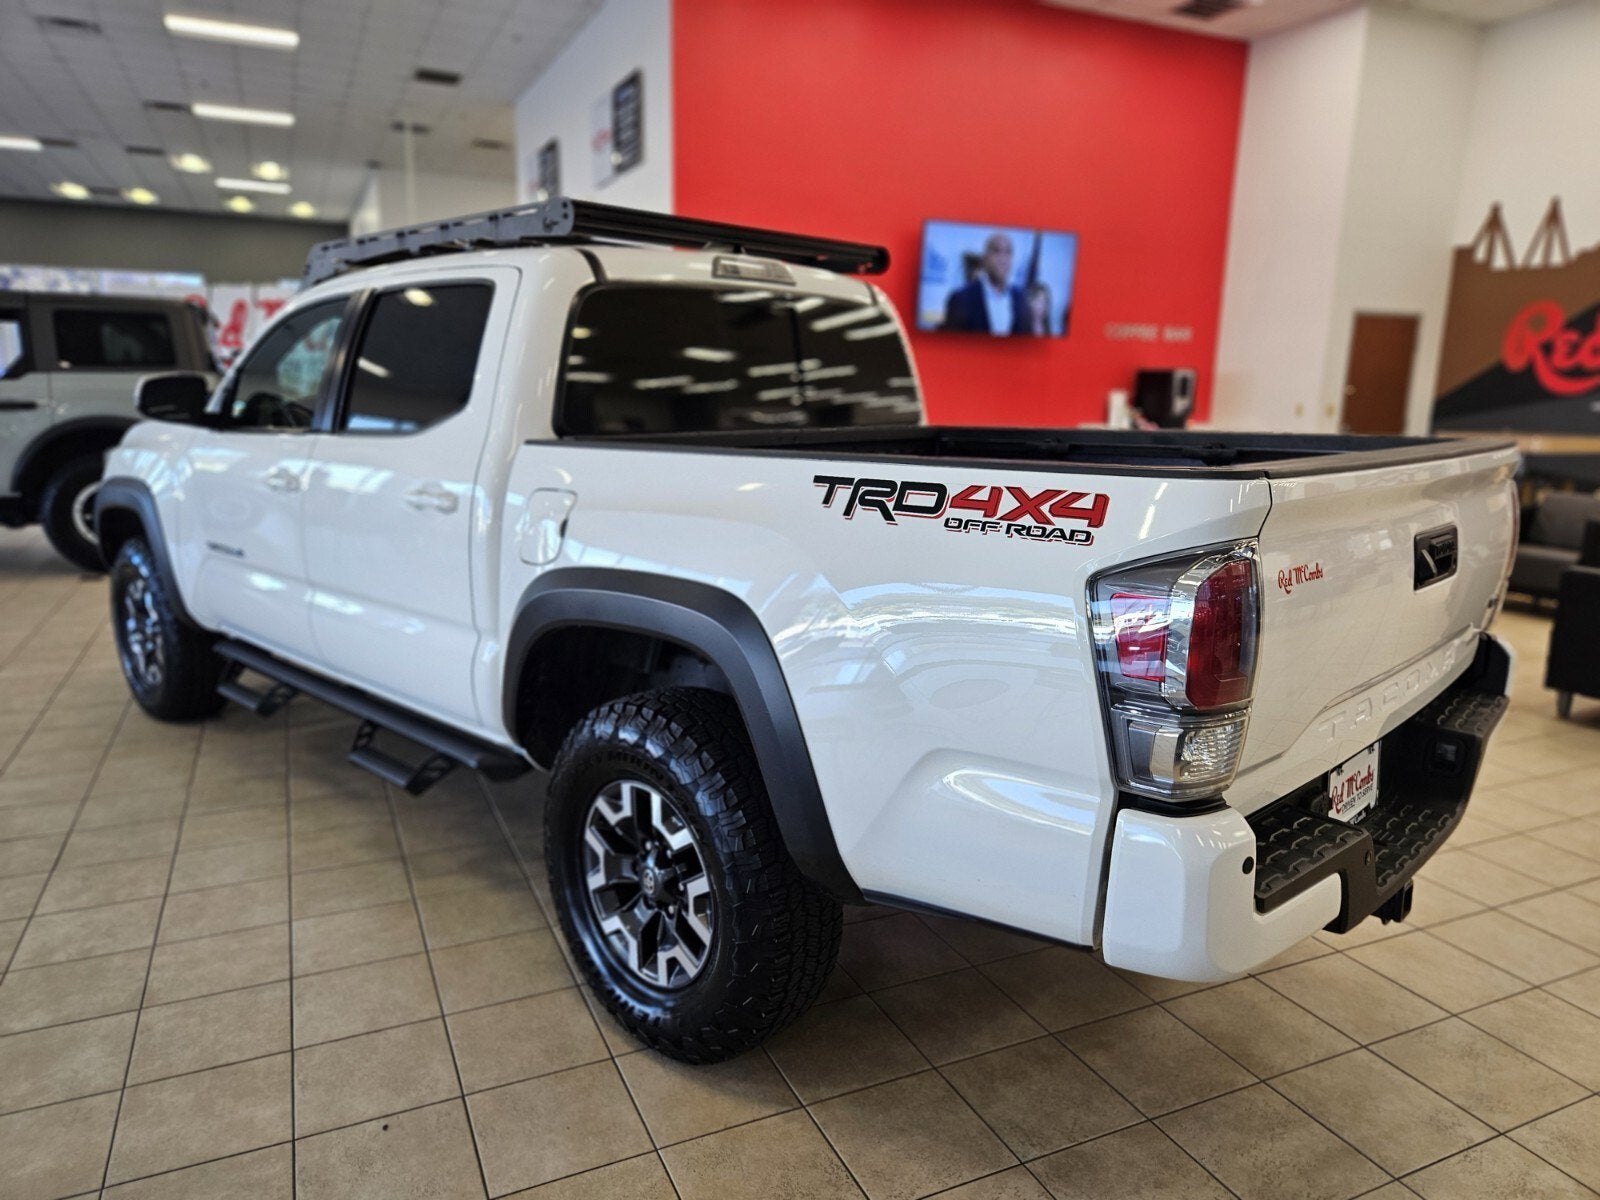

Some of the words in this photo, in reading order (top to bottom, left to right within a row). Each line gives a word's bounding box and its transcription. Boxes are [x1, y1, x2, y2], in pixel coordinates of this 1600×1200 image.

[812, 474, 948, 526] TRD
[949, 484, 1111, 529] 4X4
[943, 516, 1003, 535] OFF
[1004, 522, 1094, 547] ROAD
[1277, 569, 1293, 595] Red
[1331, 781, 1345, 814] Red
